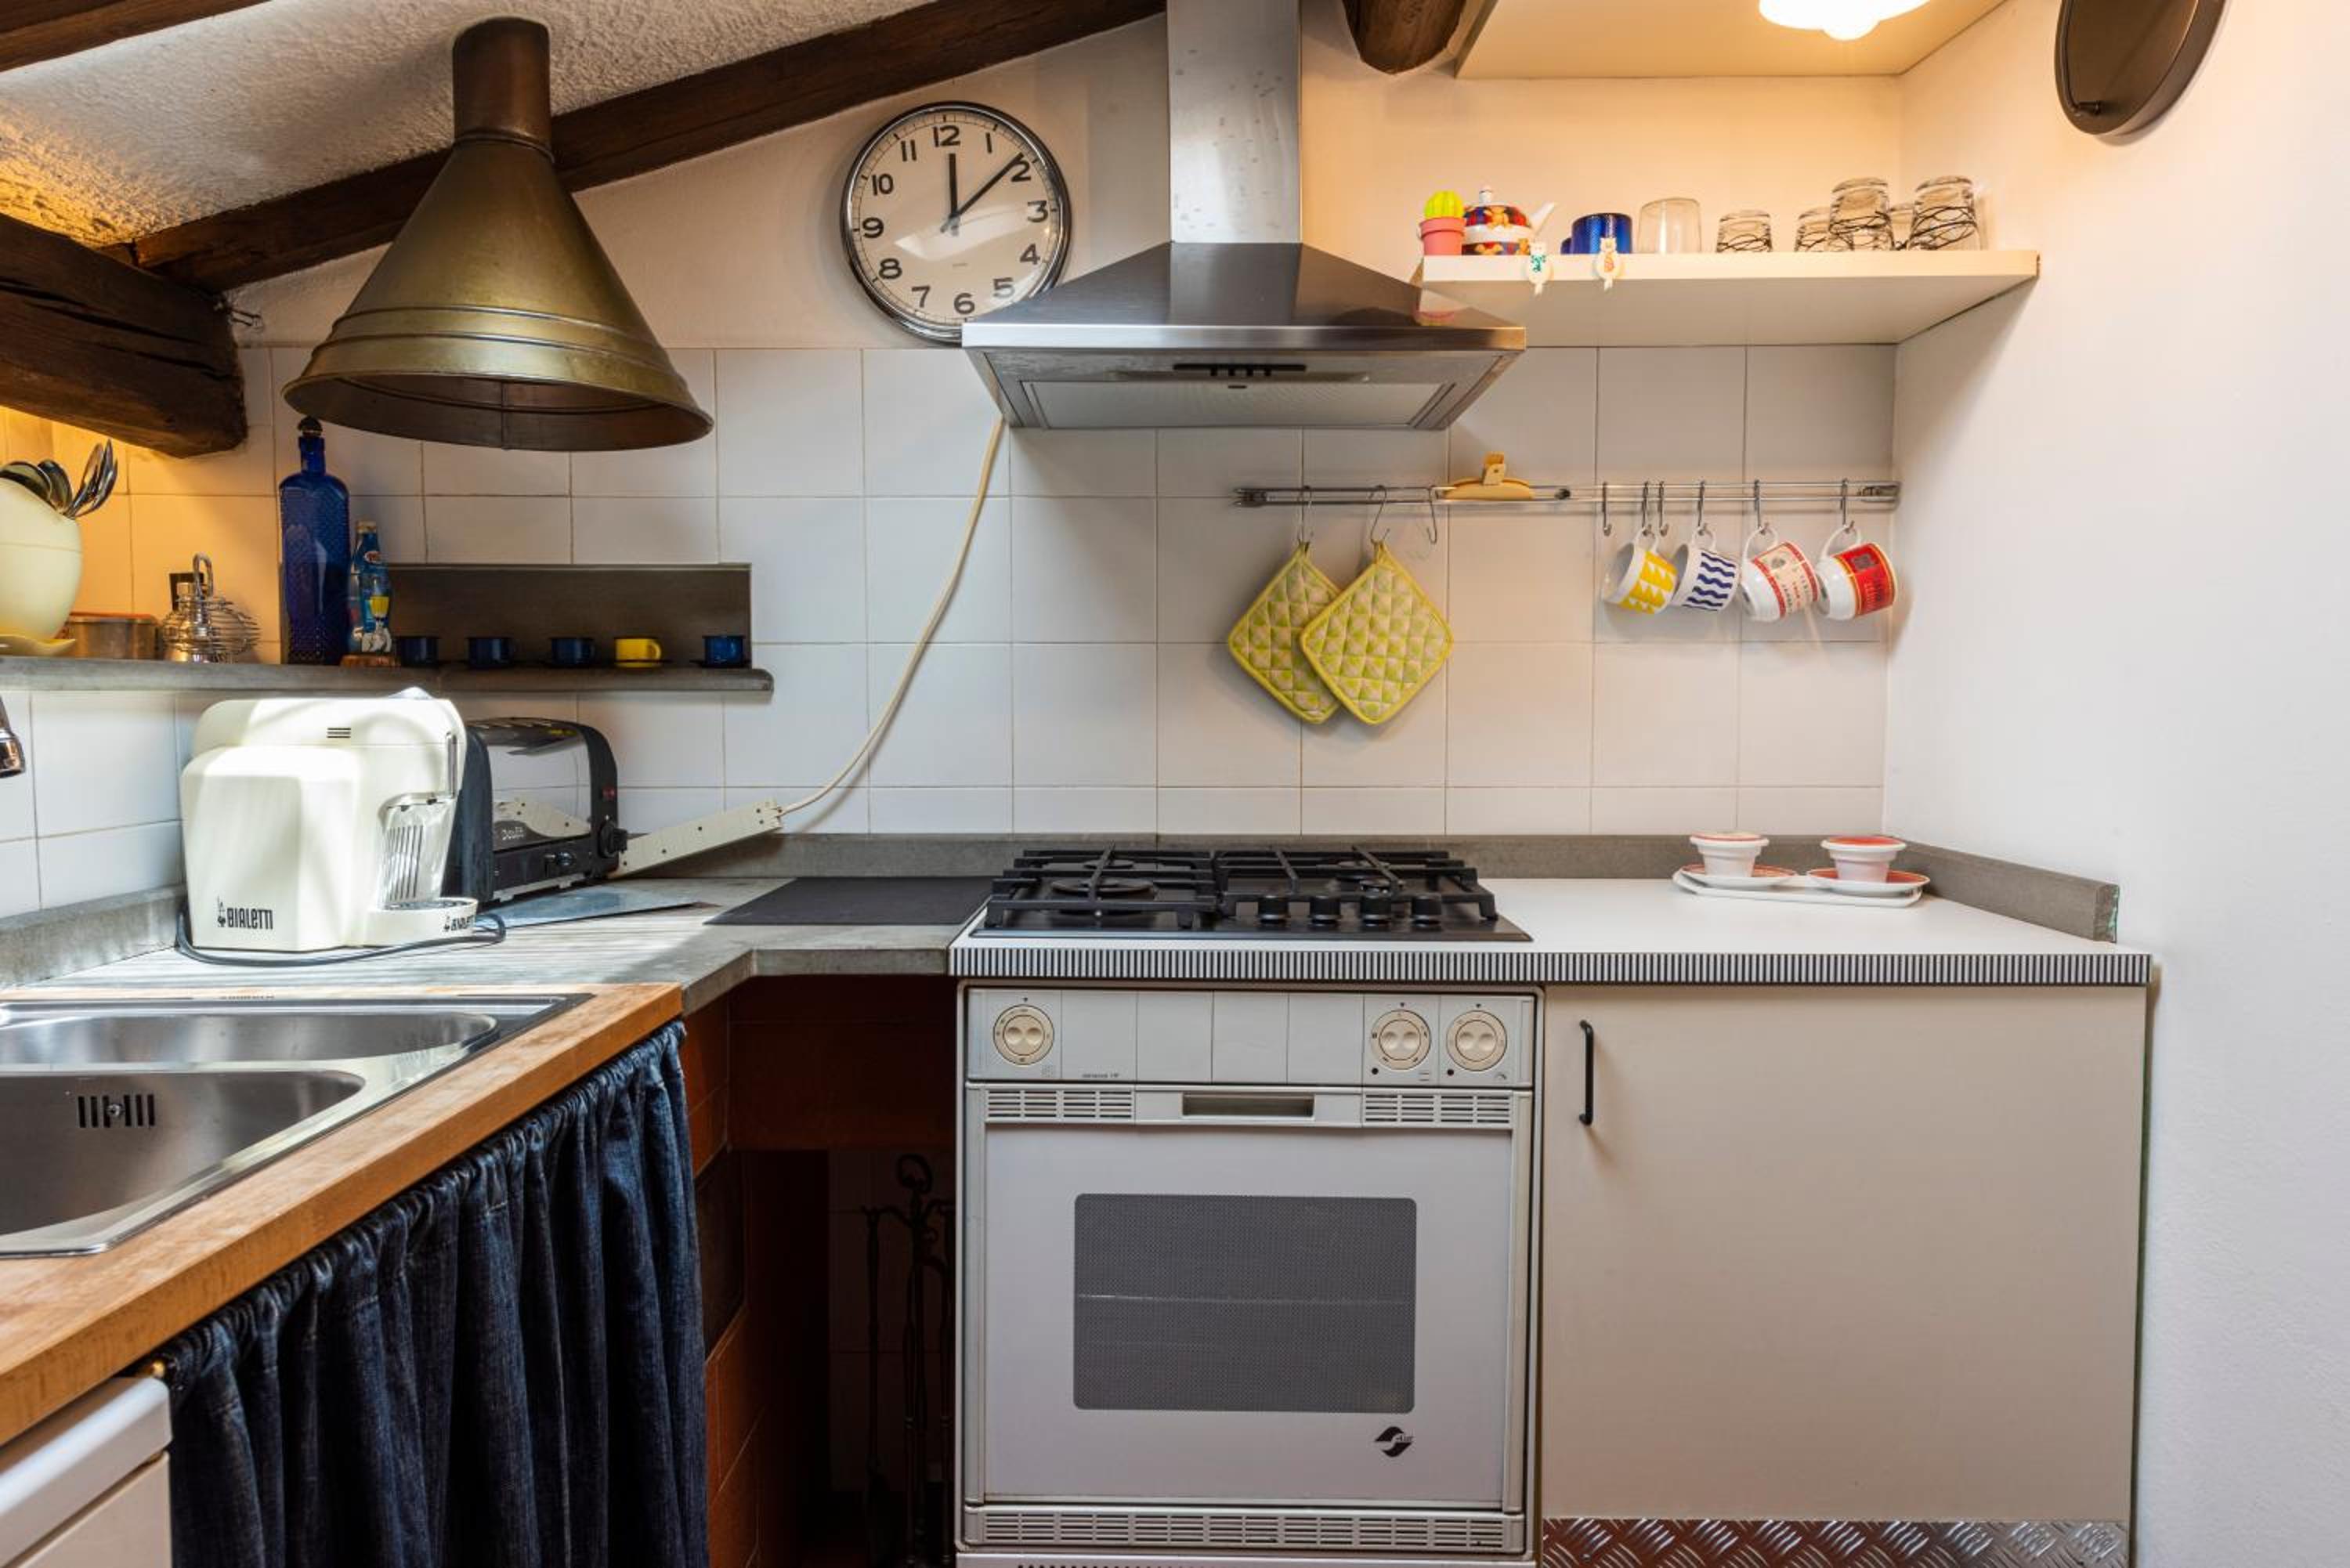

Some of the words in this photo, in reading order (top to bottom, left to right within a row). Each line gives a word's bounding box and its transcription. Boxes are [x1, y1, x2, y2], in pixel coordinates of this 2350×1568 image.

[933, 125, 960, 147] 12
[985, 132, 993, 154] 1
[901, 139, 917, 161] 11
[1010, 159, 1031, 182] 2
[872, 173, 894, 195] 10
[1027, 200, 1049, 222] 3
[862, 217, 884, 238] 9
[1019, 244, 1041, 265] 4
[878, 258, 902, 280] 8
[911, 286, 931, 308] 7
[992, 277, 1015, 297] 5
[953, 293, 975, 314] 6
